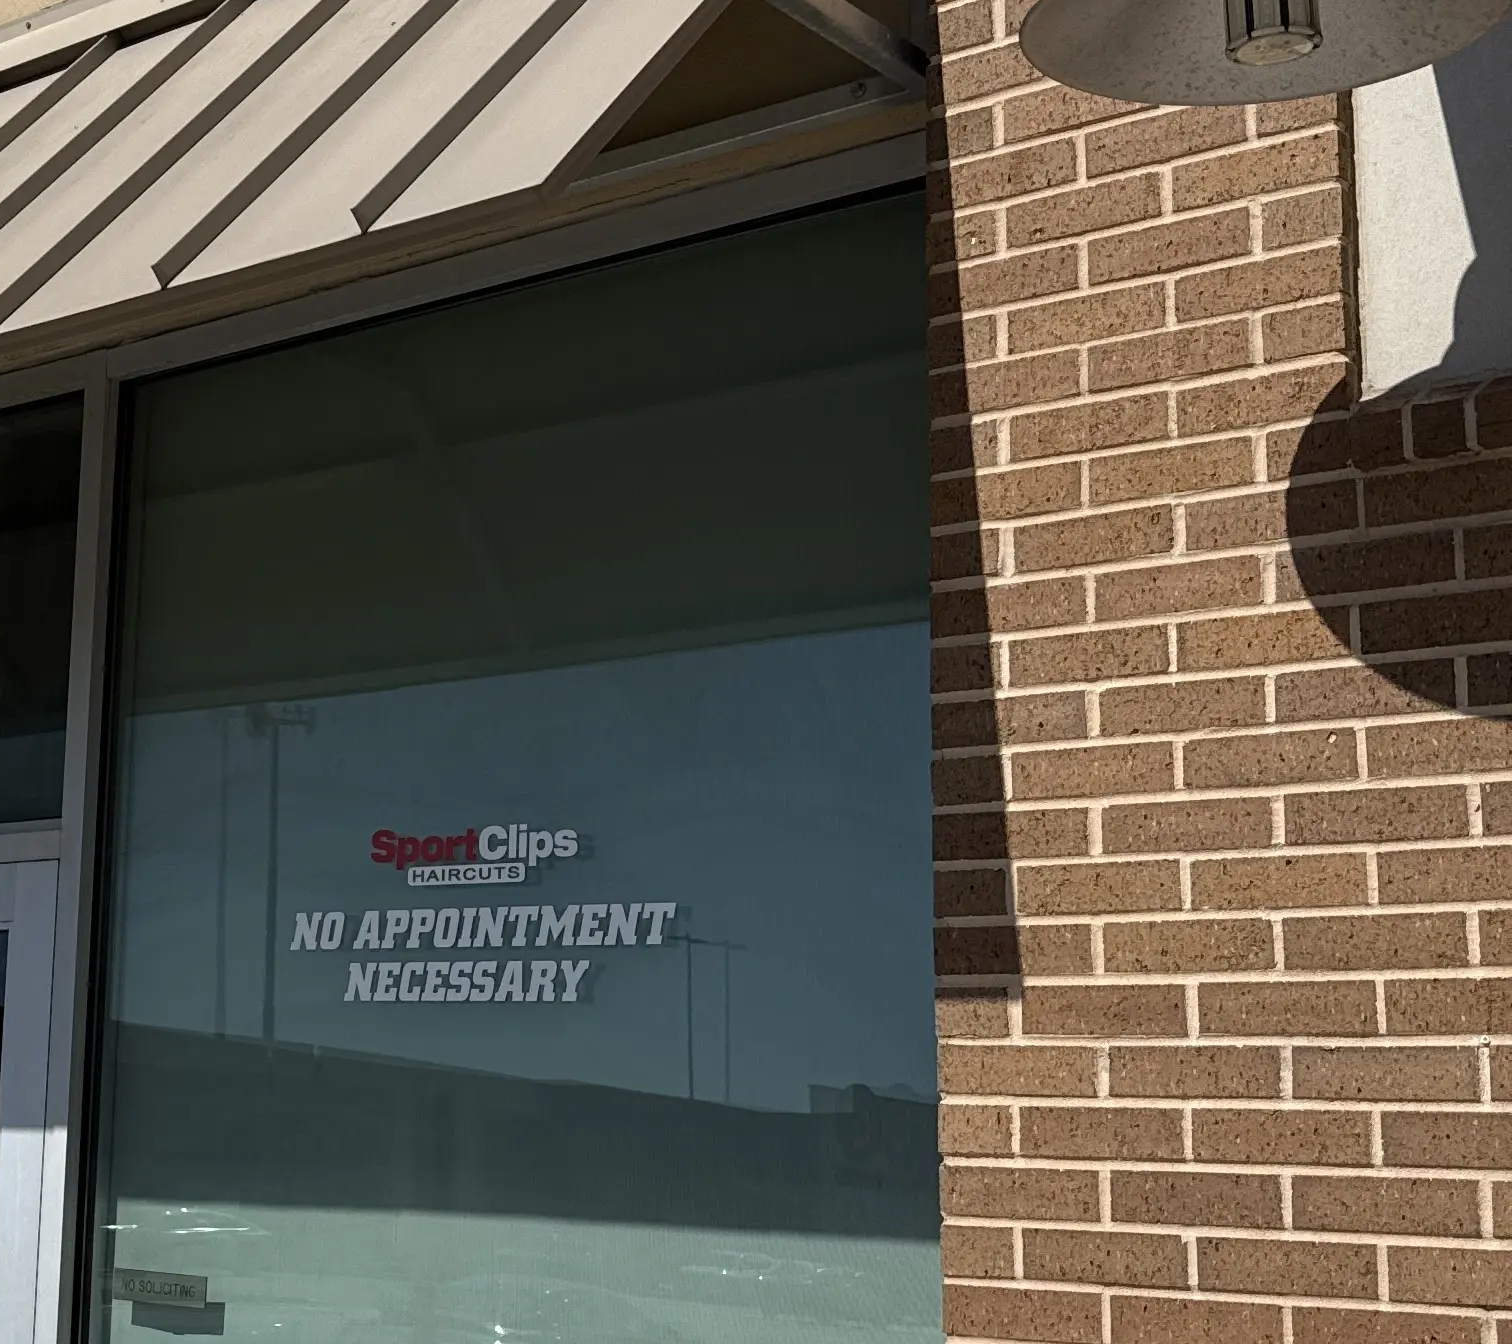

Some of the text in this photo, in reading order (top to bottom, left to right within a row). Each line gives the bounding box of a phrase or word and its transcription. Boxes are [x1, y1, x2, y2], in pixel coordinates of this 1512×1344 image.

[370, 824, 579, 869] SportClips
[411, 865, 522, 883] HAIRCUTS
[289, 902, 677, 950] NO APPOINTMENT
[343, 960, 590, 1002] NECESSARY
[121, 1278, 197, 1298] NO SOLICITING
